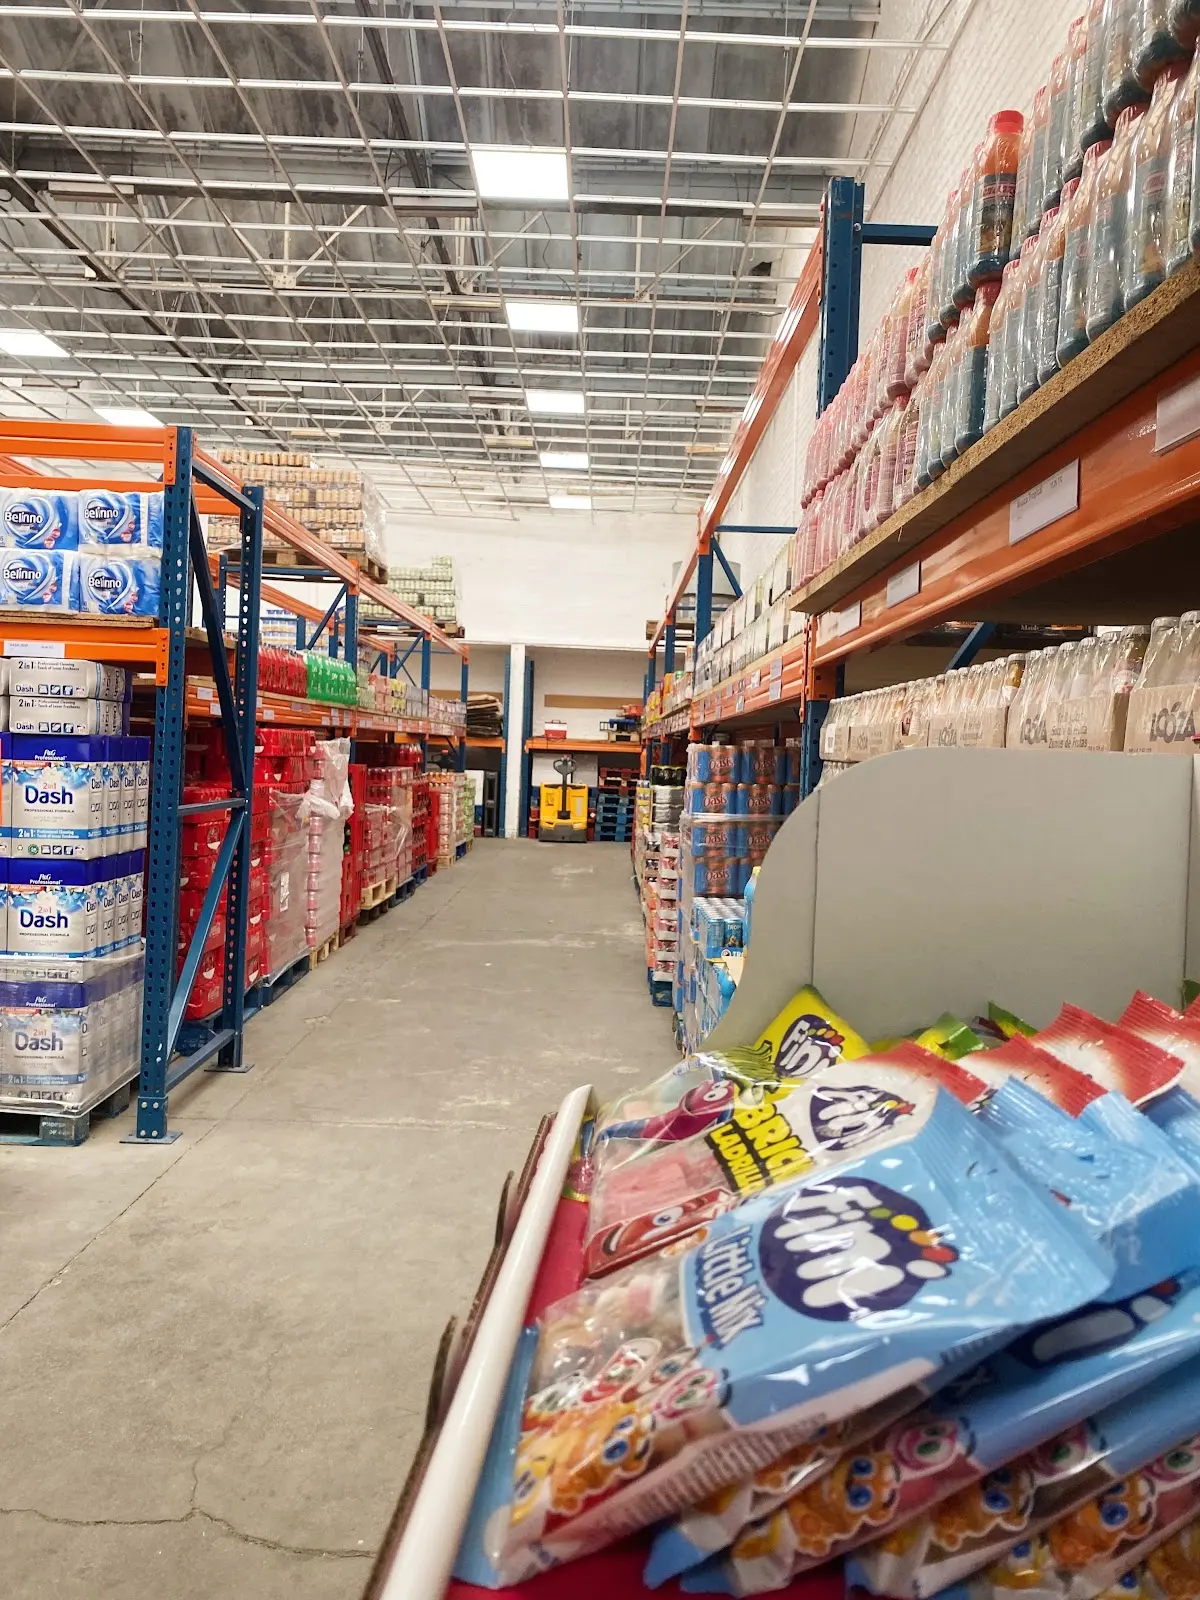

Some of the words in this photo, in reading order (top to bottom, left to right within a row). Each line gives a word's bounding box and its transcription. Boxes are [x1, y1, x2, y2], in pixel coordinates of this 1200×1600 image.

[4, 511, 43, 524] Belinno
[84, 507, 119, 520] Belinno
[3, 567, 42, 580] Belinno
[88, 577, 122, 589] Belinno
[15, 684, 34, 693] Dash
[16, 722, 34, 730] Dash
[708, 756, 734, 771] Oasis
[752, 757, 776, 771] Oasis
[43, 782, 57, 790] 2in1
[24, 785, 73, 805] Dash
[703, 794, 728, 808] Oasis
[747, 795, 772, 808] Oasis
[704, 831, 728, 845] Oasis
[748, 832, 771, 846] Oasis
[704, 868, 730, 882] Oasis
[37, 906, 52, 914] 2in1
[19, 909, 69, 929] Dash
[32, 1028, 47, 1036] 2in1
[15, 1031, 64, 1051] Dash
[774, 1184, 949, 1309] Fini
[702, 1224, 754, 1303] Little
[708, 1282, 767, 1345] Mix
